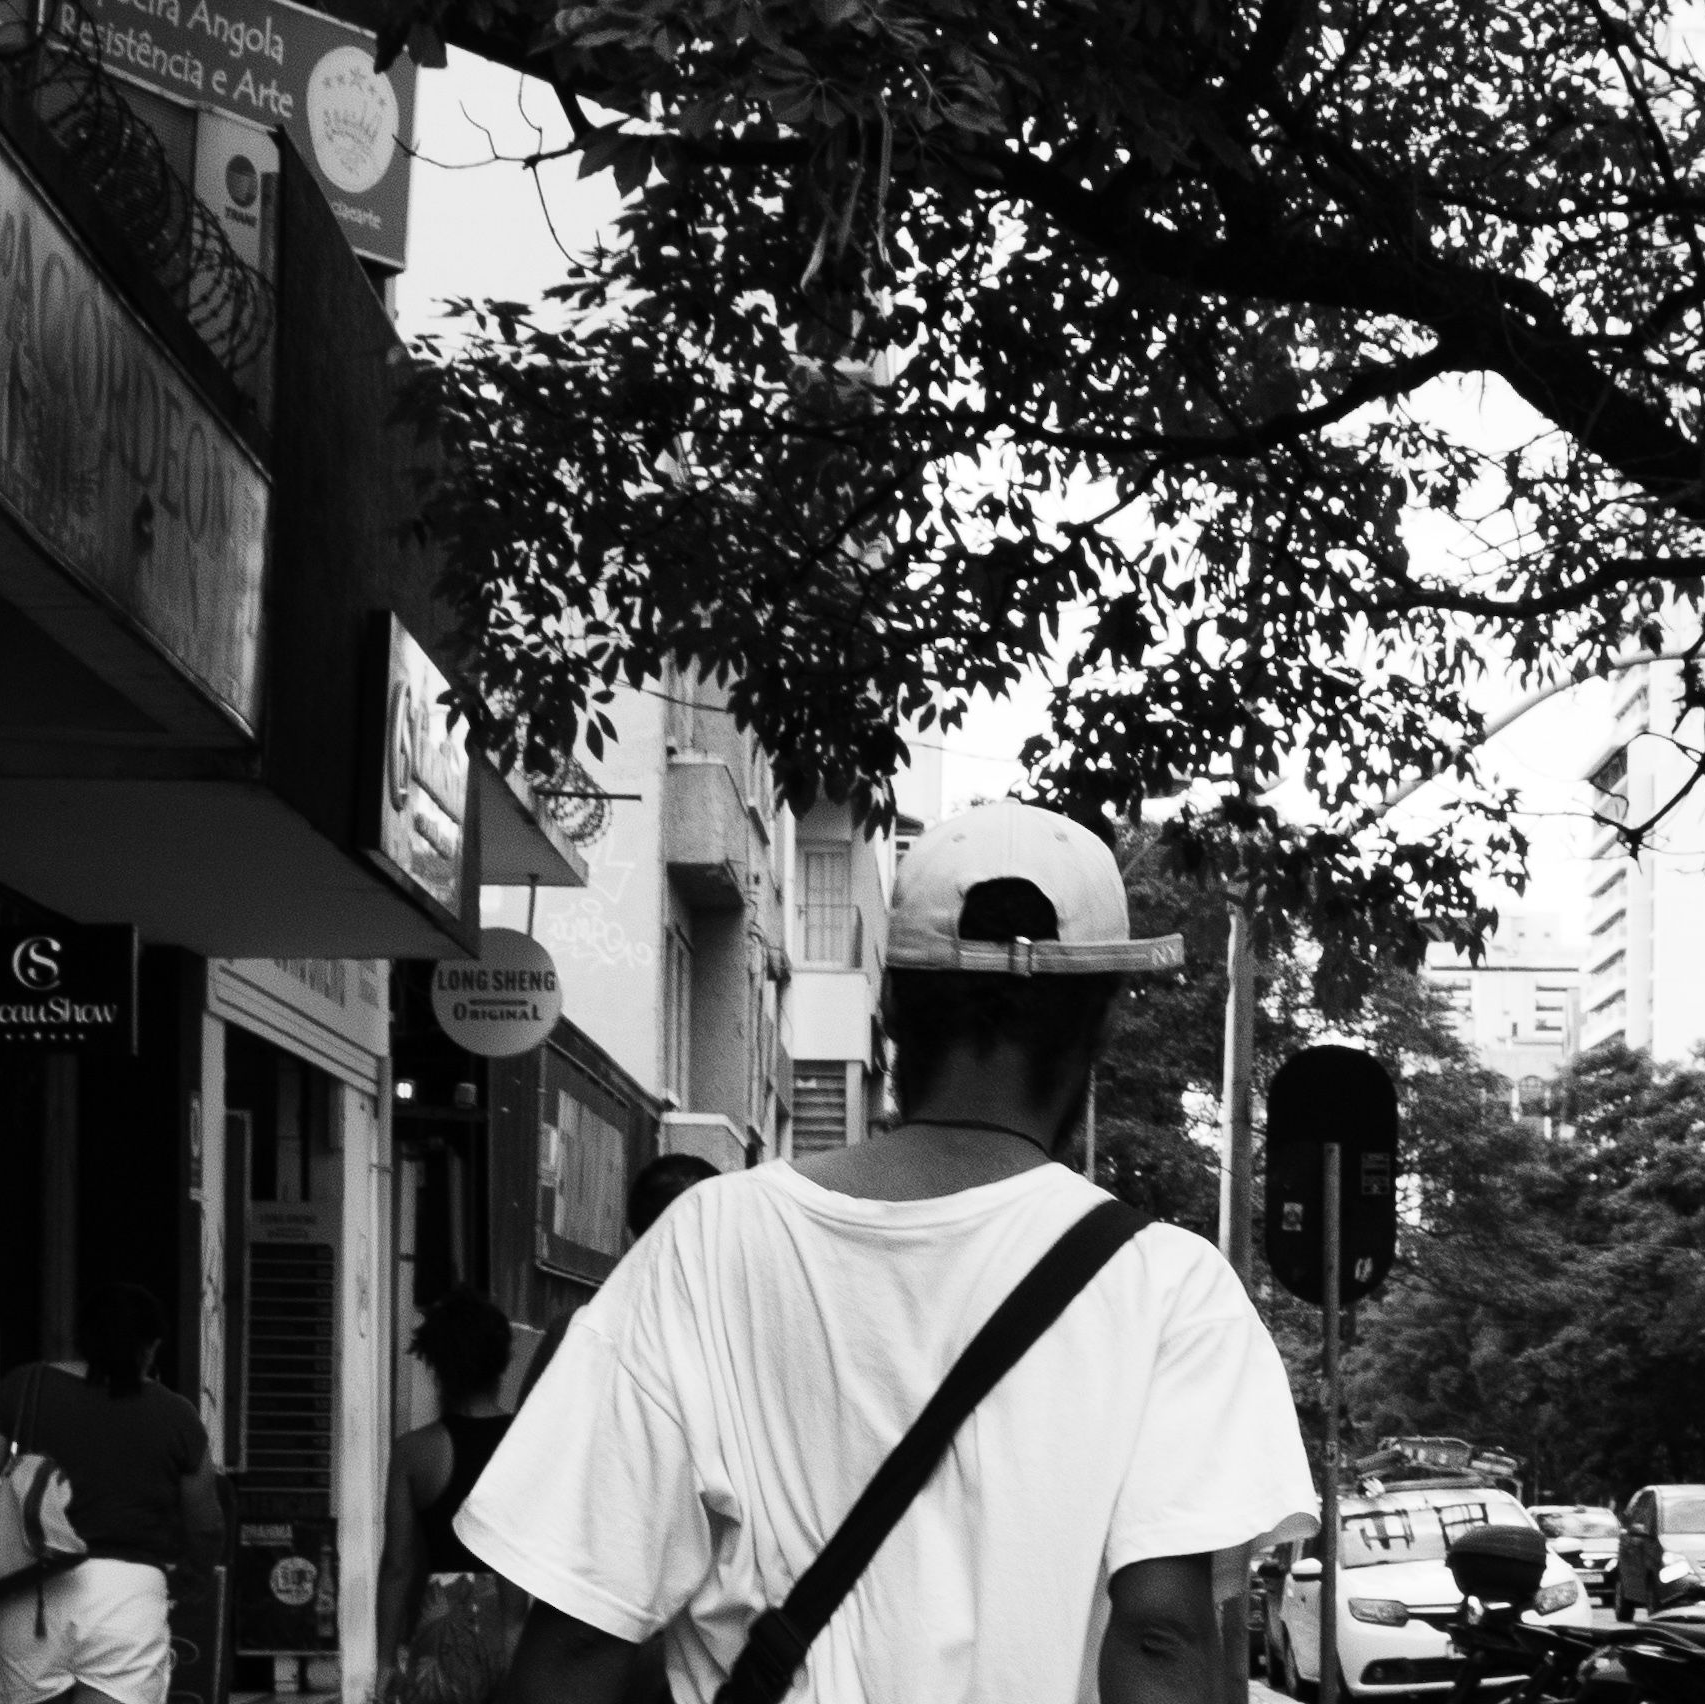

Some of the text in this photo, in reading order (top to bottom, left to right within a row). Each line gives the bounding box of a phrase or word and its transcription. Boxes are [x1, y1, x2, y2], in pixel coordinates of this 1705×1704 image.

[59, 4, 296, 120] Resistência e Arte
[187, 0, 285, 66] Angola
[437, 969, 557, 992] LONG SHENG
